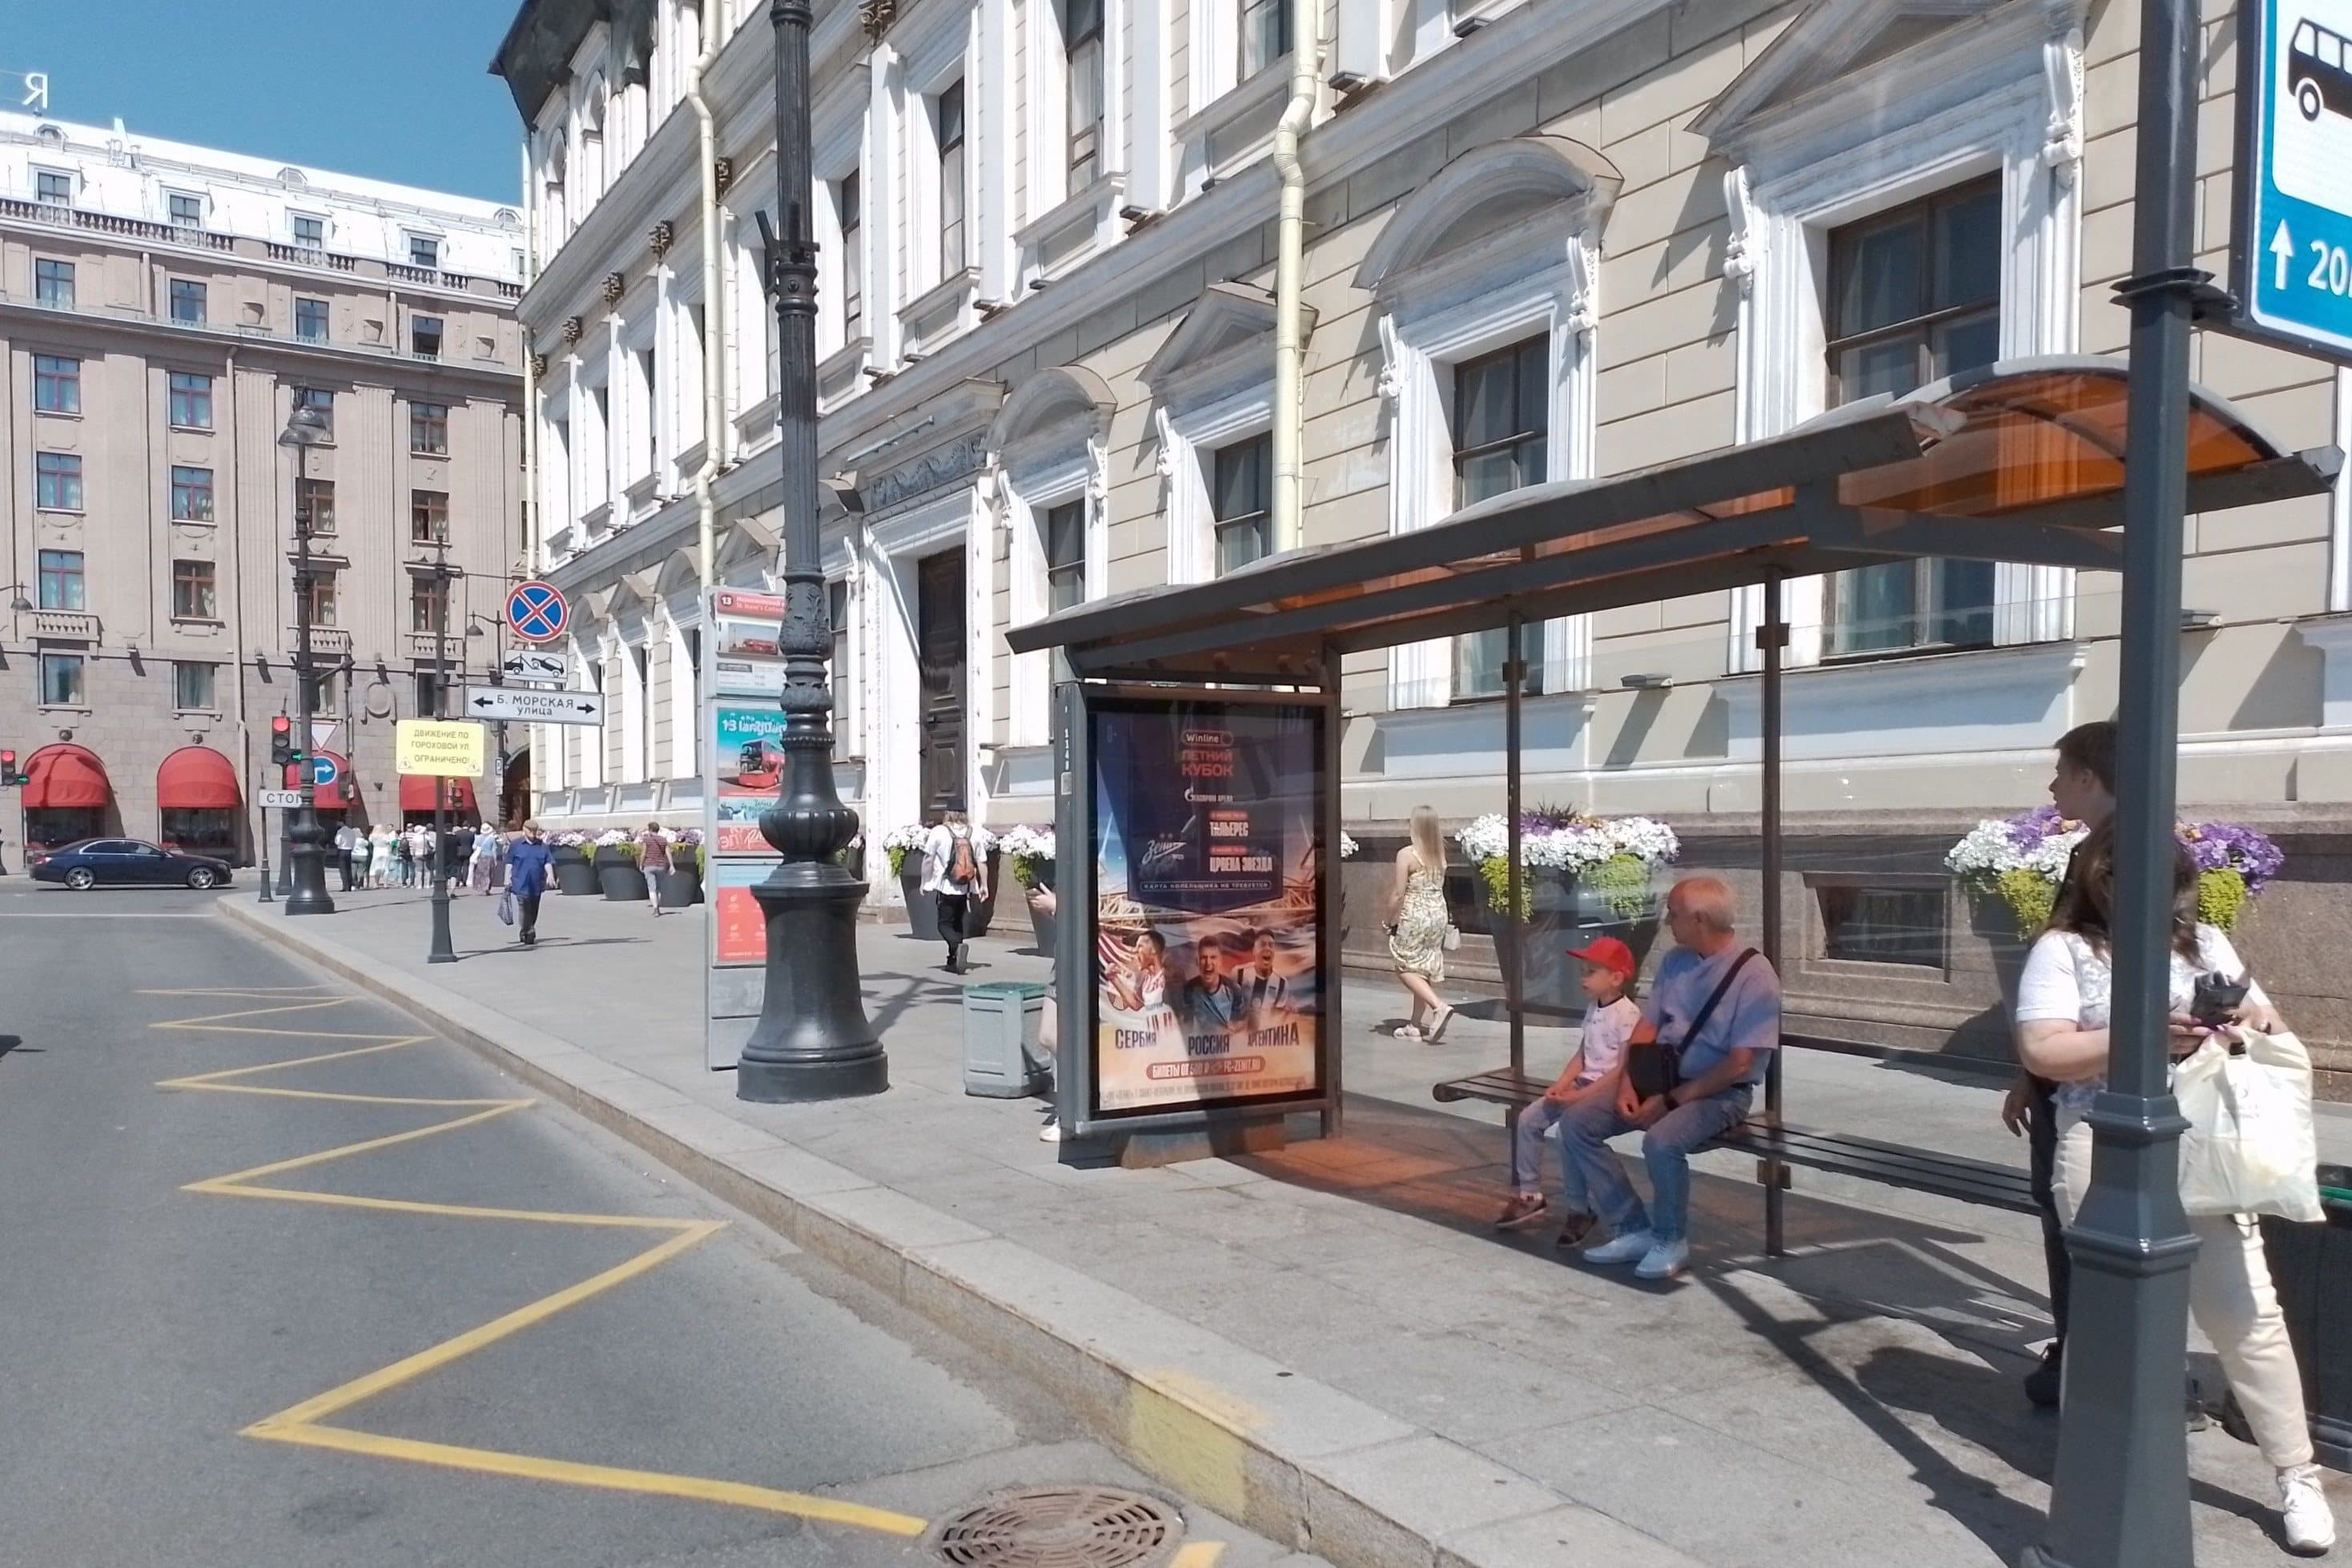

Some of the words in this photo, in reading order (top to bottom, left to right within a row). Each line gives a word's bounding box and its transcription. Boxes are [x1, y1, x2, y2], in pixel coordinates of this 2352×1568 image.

[2307, 239, 2352, 299] 20
[497, 694, 509, 704] Б.
[512, 695, 573, 709] МОРСКАЯ
[517, 706, 553, 716] улица
[722, 719, 737, 732] 13
[414, 729, 456, 738] ДВИЖЕНИЕ
[458, 731, 469, 739] ПО
[1185, 733, 1220, 743] Winline
[411, 740, 458, 750] ГОРОХОВОЙ
[414, 754, 470, 764] ОГРАНИЧЕНО!
[1181, 763, 1233, 776] КУБОК
[1115, 1029, 1156, 1049] СЕРБИЯ
[1188, 1034, 1230, 1055] РОССИЯ
